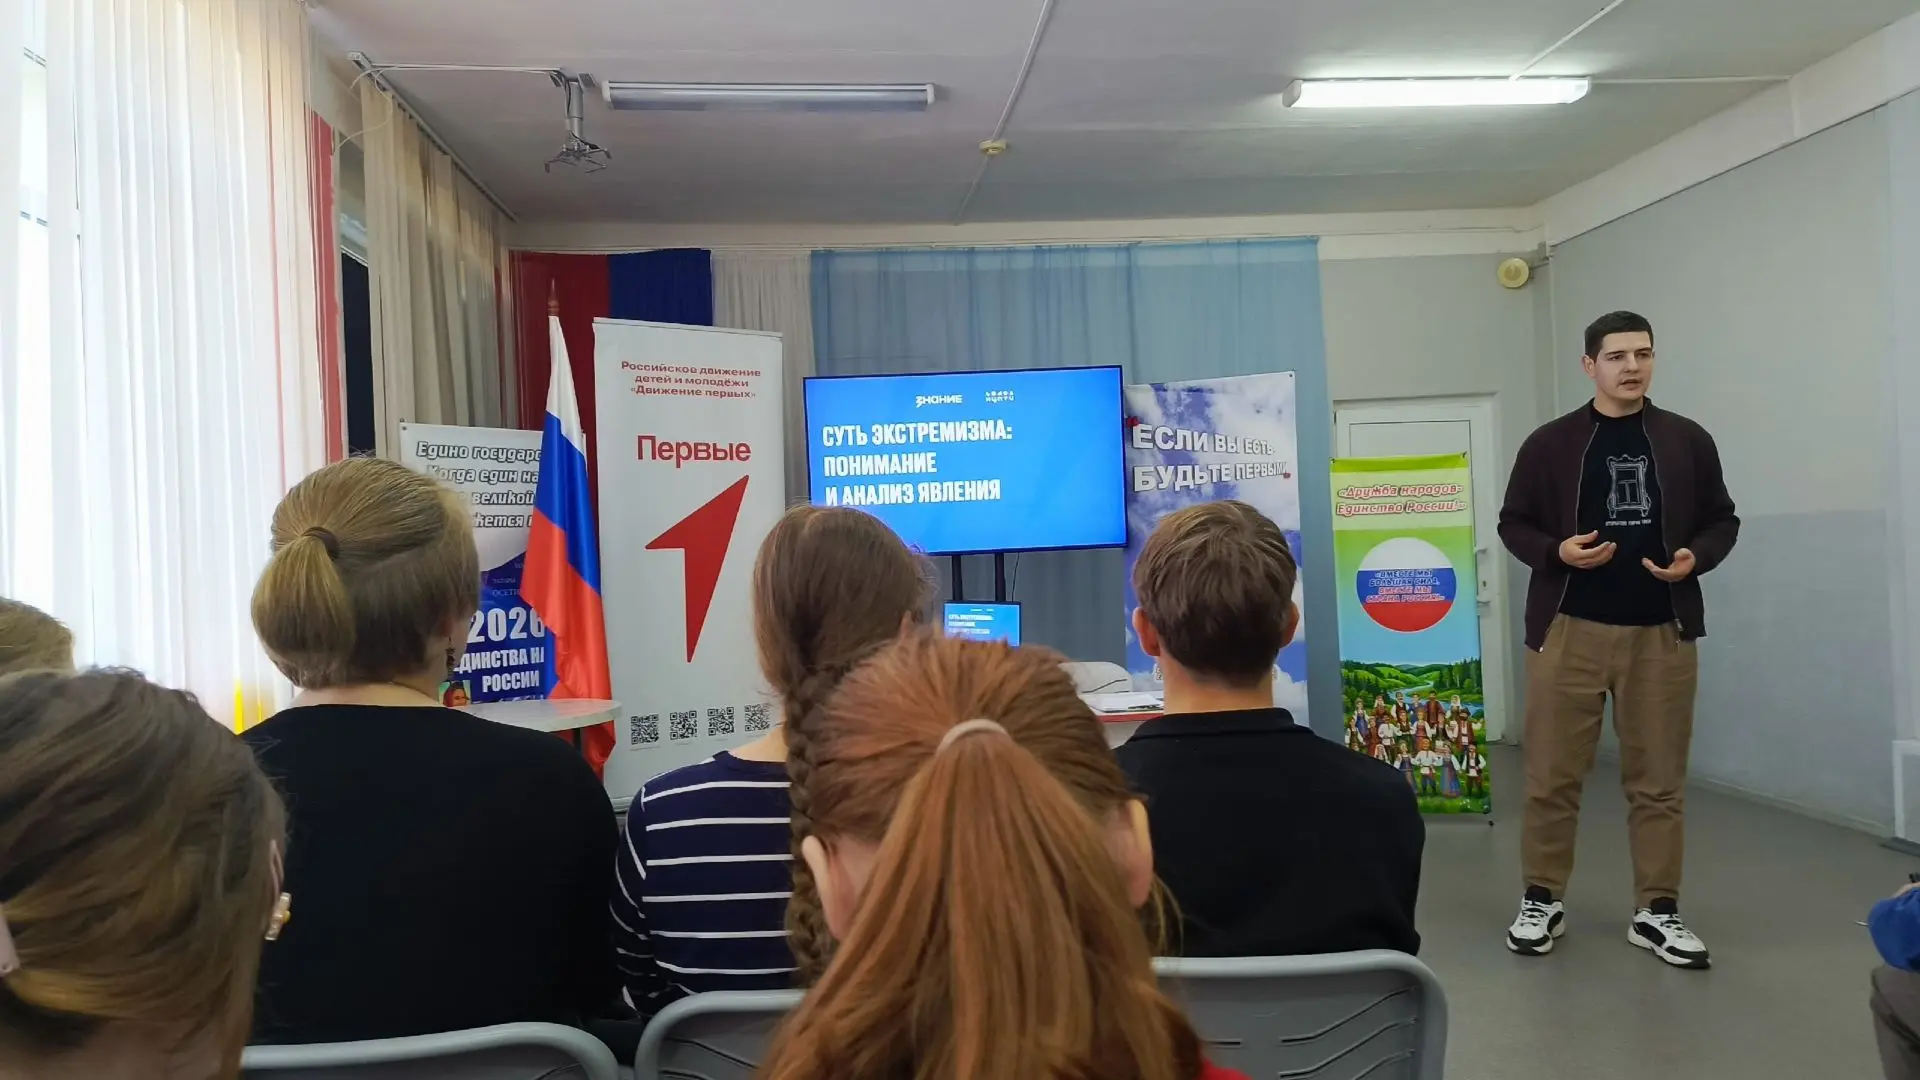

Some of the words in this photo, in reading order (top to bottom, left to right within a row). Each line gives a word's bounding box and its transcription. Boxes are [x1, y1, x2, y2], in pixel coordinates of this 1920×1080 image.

[621, 361, 698, 374] Российское
[699, 367, 761, 377] движение
[631, 385, 702, 396] «Движение
[635, 375, 672, 384] детей
[685, 377, 749, 388] молодёжи
[822, 424, 868, 447] СУТЬ
[871, 419, 1013, 445] ЭКСТРЕМИЗМА:
[1214, 432, 1241, 453] ВЫ
[416, 441, 469, 460] Едино
[637, 435, 751, 469] Первые
[824, 451, 937, 477] ПОНИМАНИЕ
[480, 469, 518, 485] един
[1133, 462, 1232, 492] БУДЬТЕ
[825, 485, 838, 507] И
[842, 483, 914, 506] АНАЛИЗ
[918, 478, 1001, 503] ЯВЛЕНИЯ
[1336, 502, 1404, 517] Единство
[482, 670, 540, 693] РОССИИ
